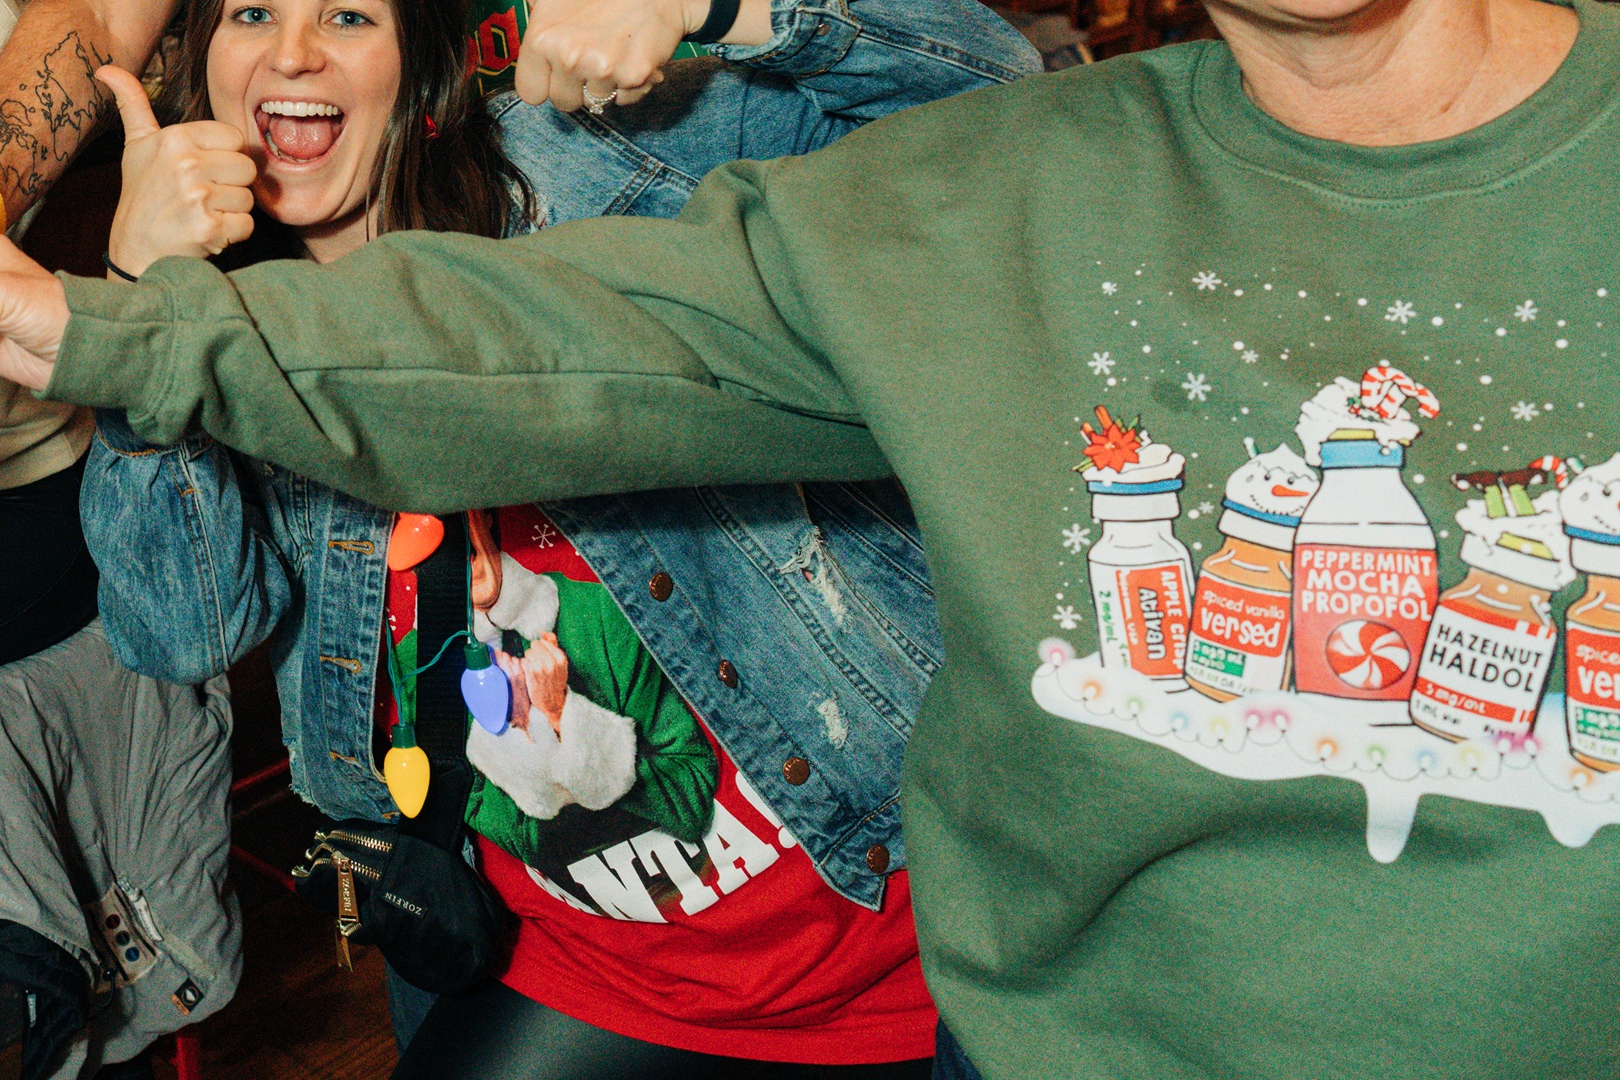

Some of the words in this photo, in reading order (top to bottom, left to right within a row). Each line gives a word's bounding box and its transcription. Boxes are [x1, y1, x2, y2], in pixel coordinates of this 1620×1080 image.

[1301, 550, 1432, 576] PEPPERMINT
[1161, 571, 1183, 617] APPLE
[1306, 569, 1426, 599] MOCHA
[1202, 589, 1244, 613] spiced
[1245, 605, 1285, 620] vanilla
[1301, 590, 1431, 621] PROPOFOL
[1138, 587, 1167, 661] Ativan
[1201, 606, 1282, 649] versed
[1437, 623, 1543, 668] HAZELNUT
[1430, 643, 1533, 692] HALDOL
[385, 892, 423, 915] ZORFIN
